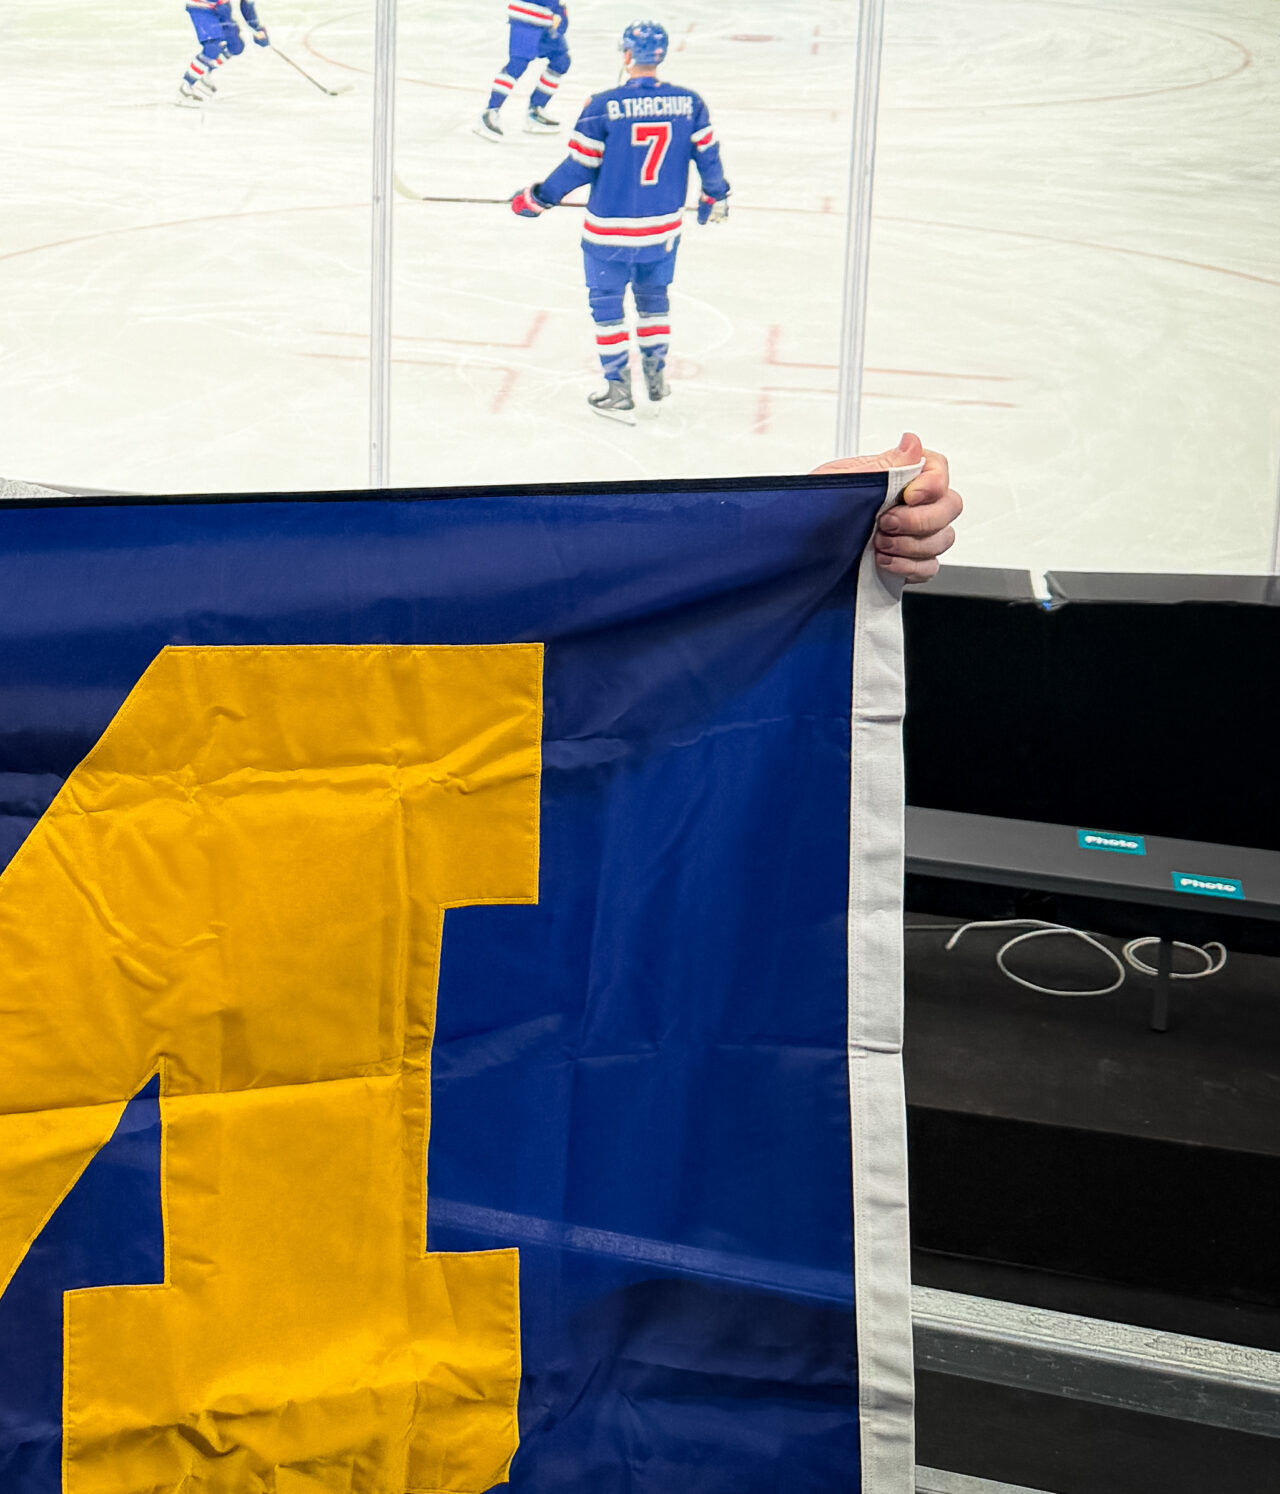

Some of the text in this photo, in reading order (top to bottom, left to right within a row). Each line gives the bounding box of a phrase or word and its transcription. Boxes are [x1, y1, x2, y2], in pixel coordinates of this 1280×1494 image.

[631, 121, 672, 186] 7
[1084, 835, 1139, 849] Photo
[1180, 878, 1237, 892] Photo
